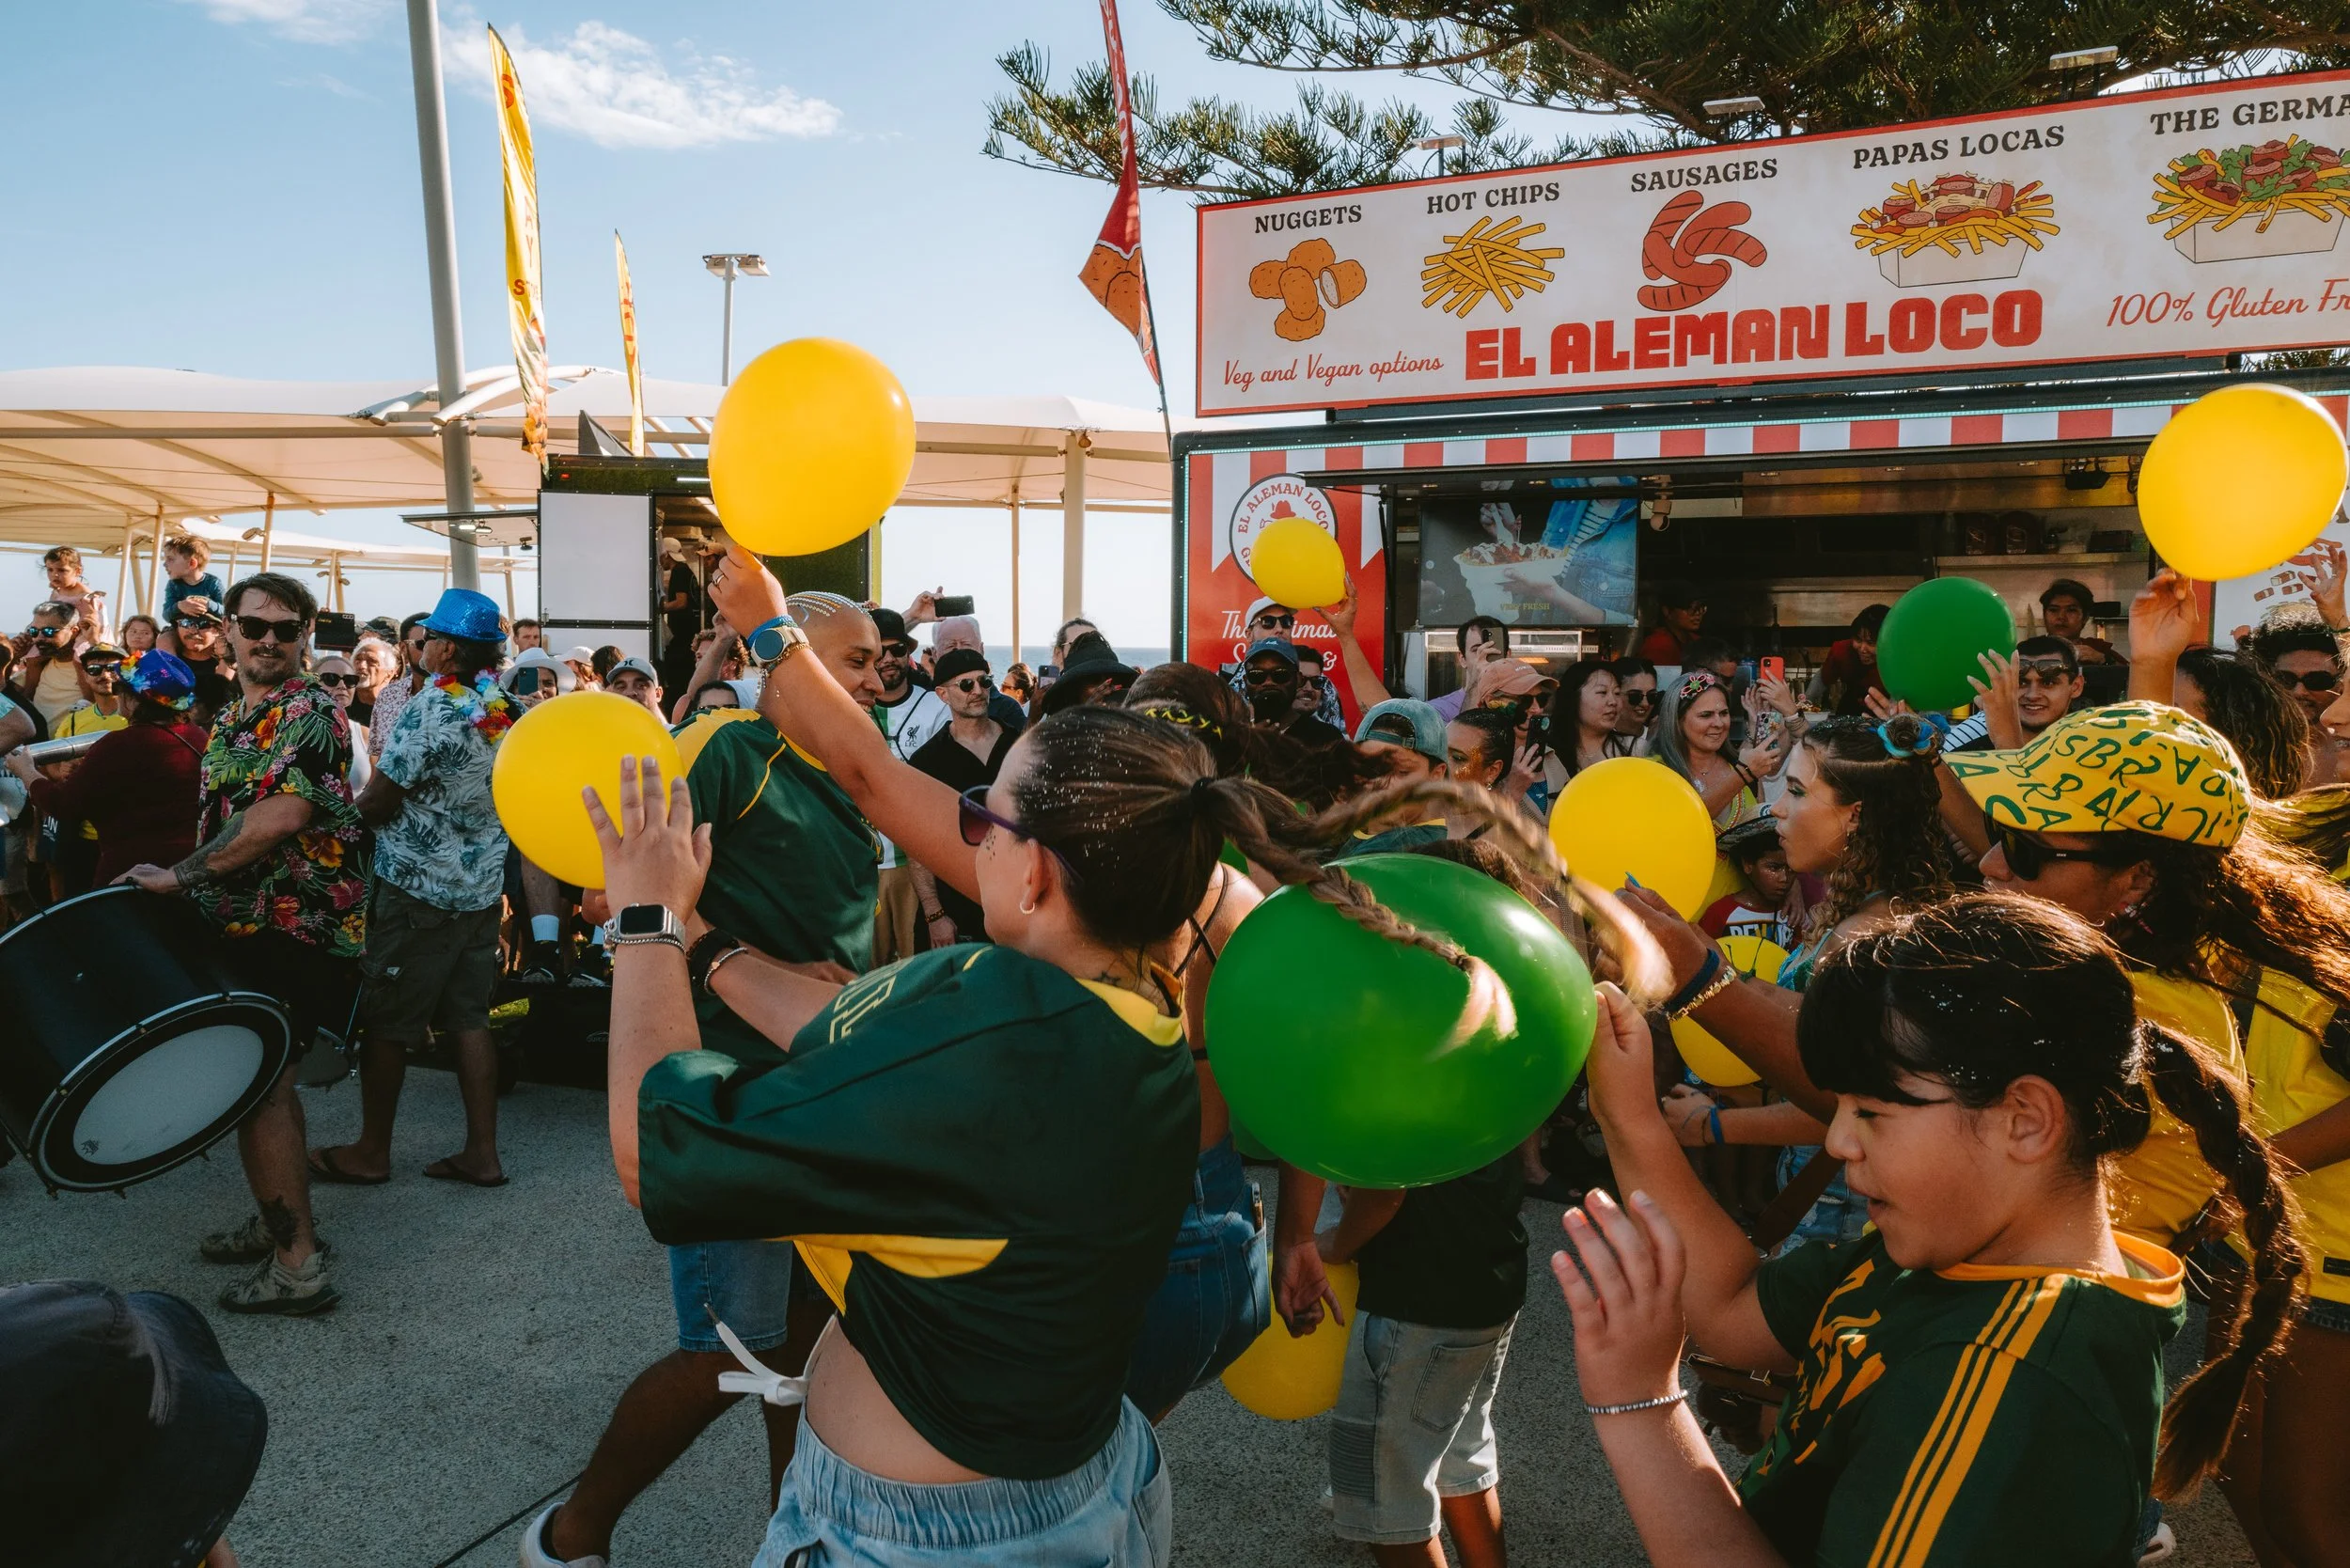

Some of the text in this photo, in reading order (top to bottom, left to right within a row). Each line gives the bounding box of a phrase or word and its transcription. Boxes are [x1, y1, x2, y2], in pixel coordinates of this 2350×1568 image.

[2150, 94, 2350, 135] THE GERMA
[1853, 124, 2065, 170] PAPAS LOCAS
[1631, 158, 1778, 193] SAUSAGES
[1255, 203, 1362, 234] NUGGETS
[1426, 181, 1561, 215] HOT CHIPS
[2107, 291, 2194, 327] 100%
[2205, 286, 2310, 327] Gluten
[1465, 289, 2044, 381] EL ALEMAN LOCO
[1224, 348, 1445, 391] Veg and Vegan options
[1237, 515, 1250, 534] EL
[1246, 482, 1305, 513] ALEMAN
